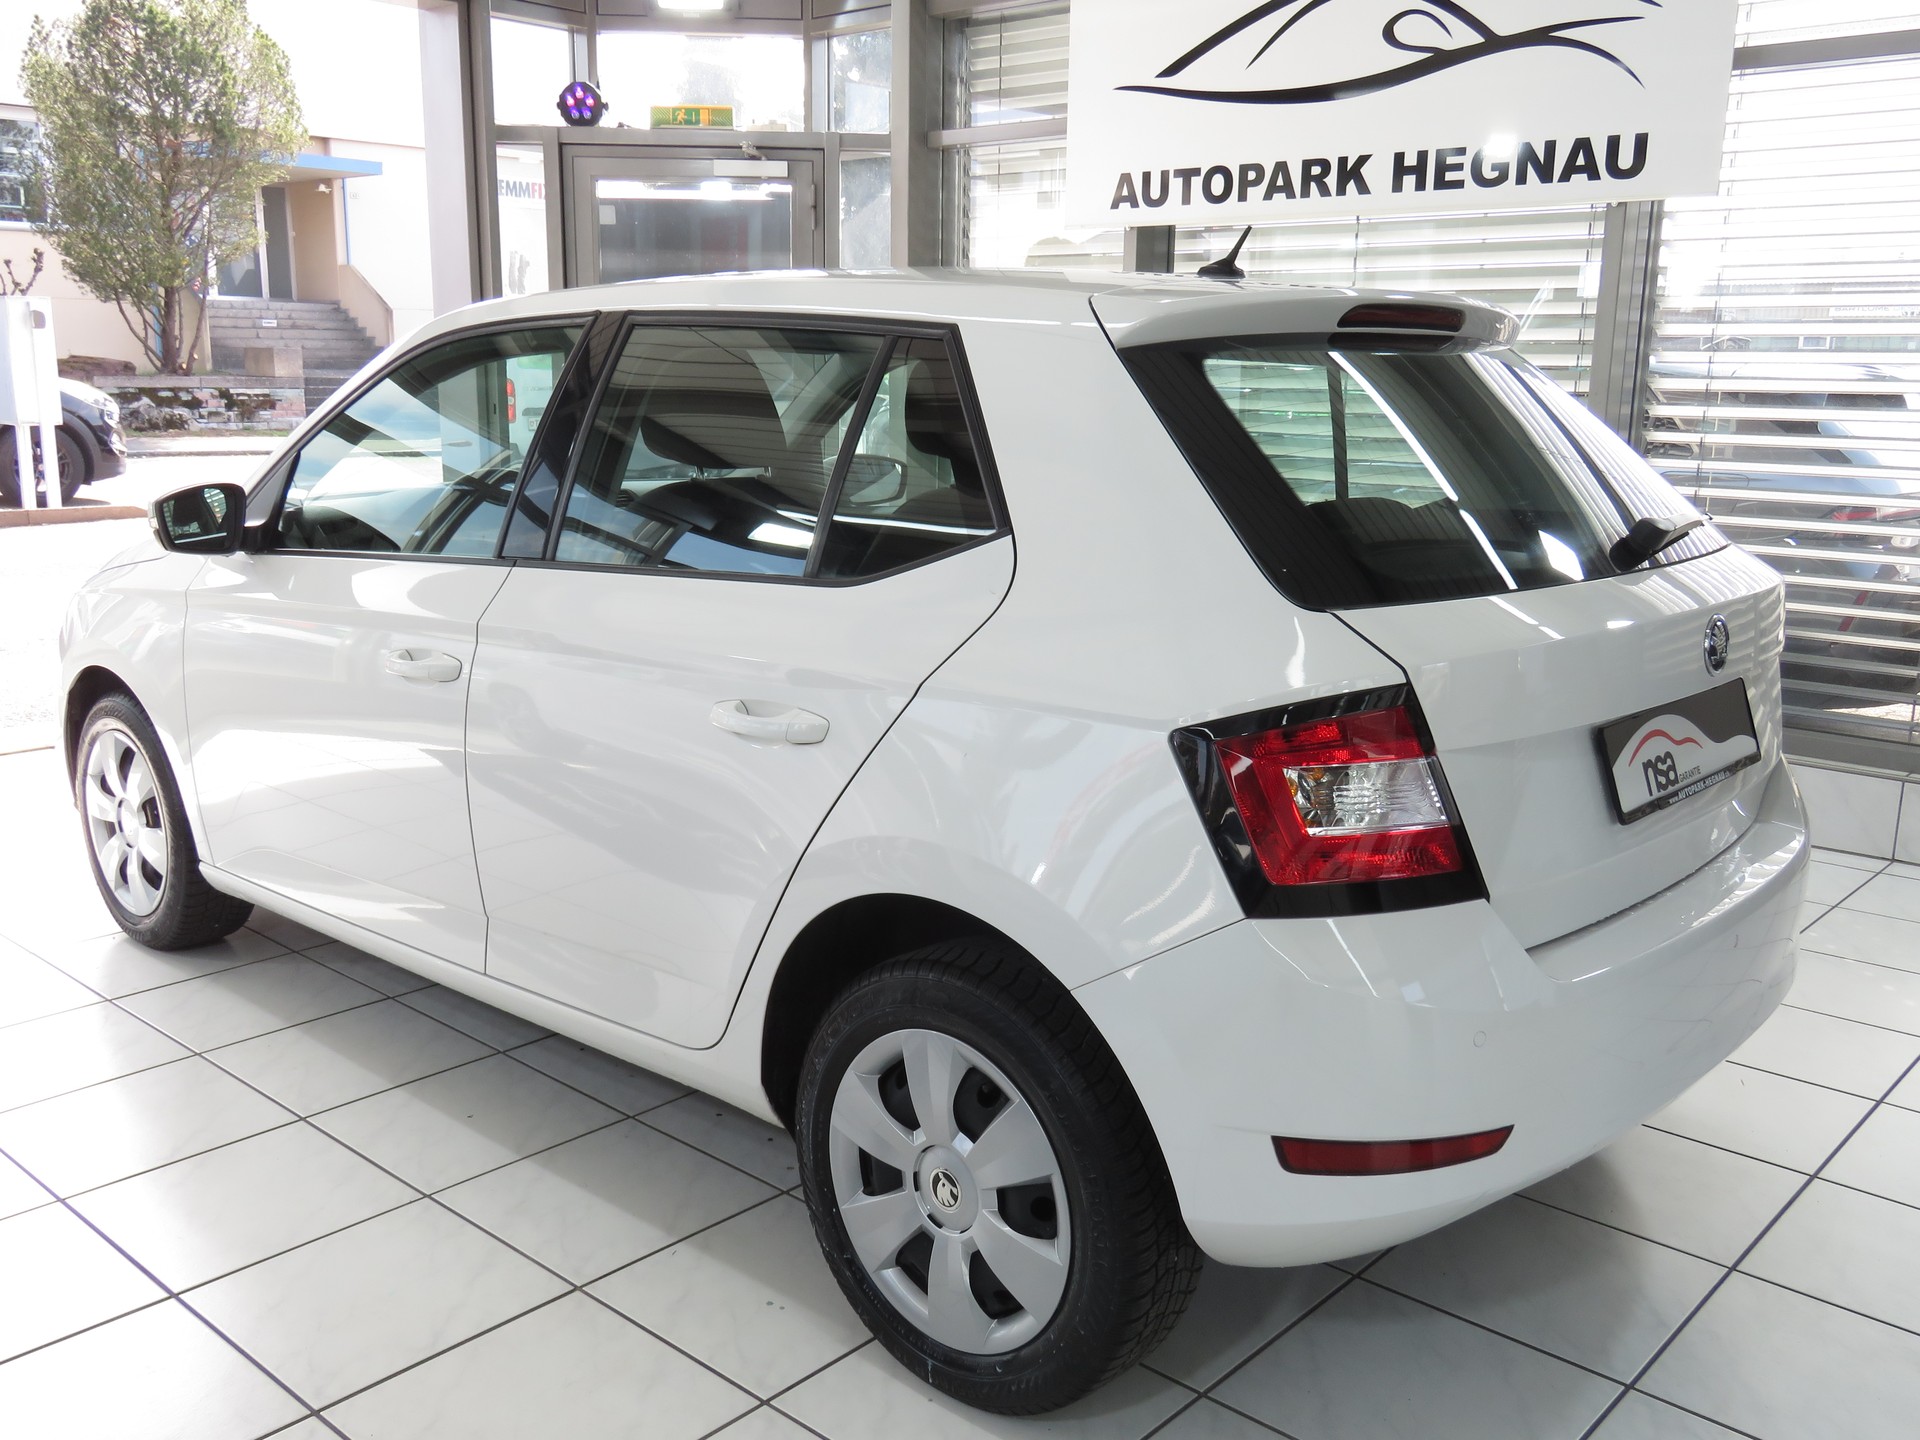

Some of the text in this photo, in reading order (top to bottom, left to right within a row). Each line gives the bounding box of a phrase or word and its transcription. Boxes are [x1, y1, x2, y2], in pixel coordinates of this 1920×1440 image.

[1110, 132, 1649, 209] AUTOPARK HEGNAU
[1642, 751, 1680, 797] nsa
